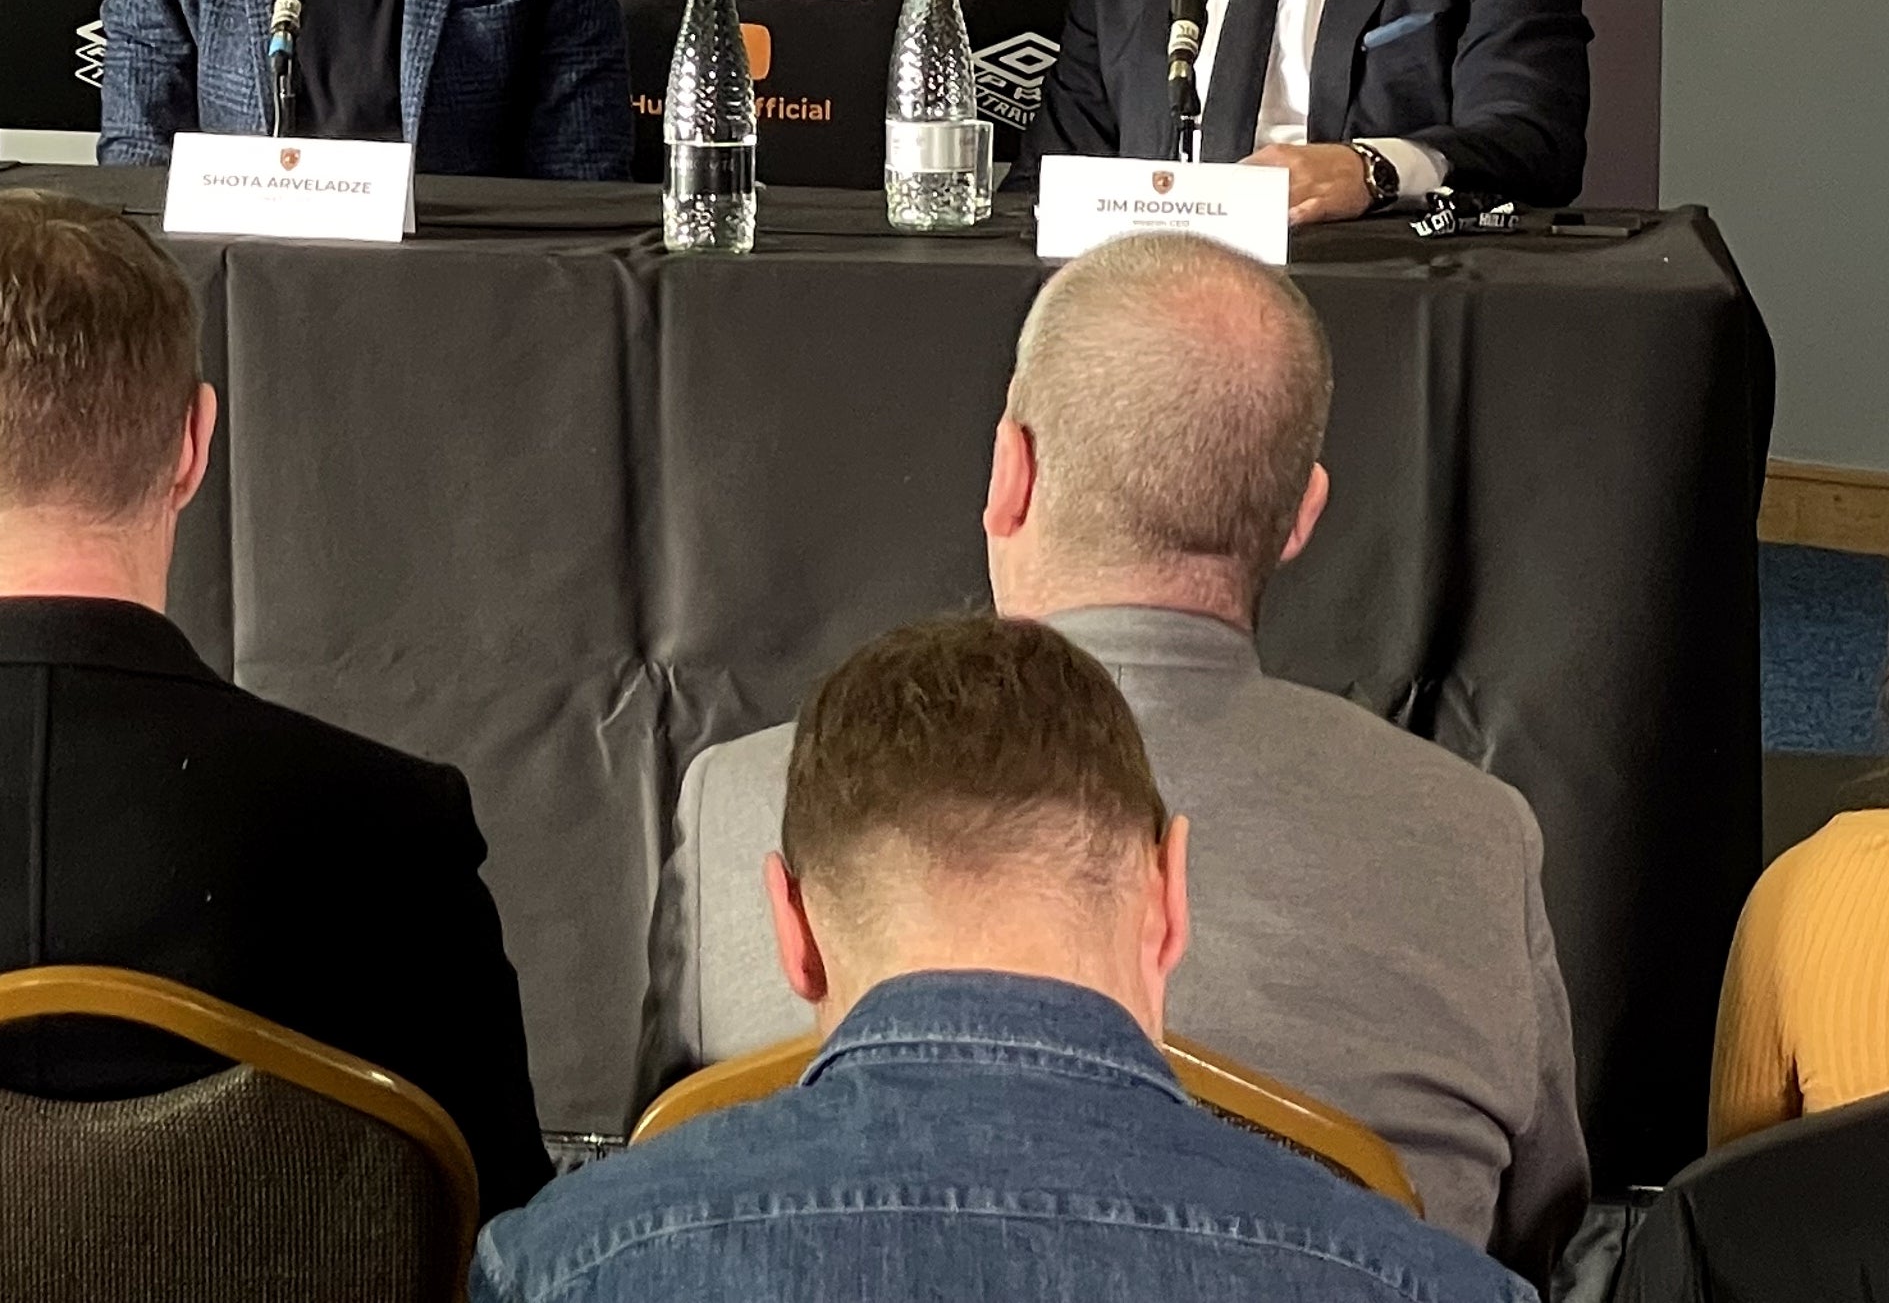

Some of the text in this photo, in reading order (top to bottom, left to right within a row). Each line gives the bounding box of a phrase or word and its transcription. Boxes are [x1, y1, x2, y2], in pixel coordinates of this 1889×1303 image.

[977, 73, 1043, 101] PR
[203, 174, 372, 194] SHOTA ARVELADZE
[1097, 198, 1228, 216] JIM RODWELL
